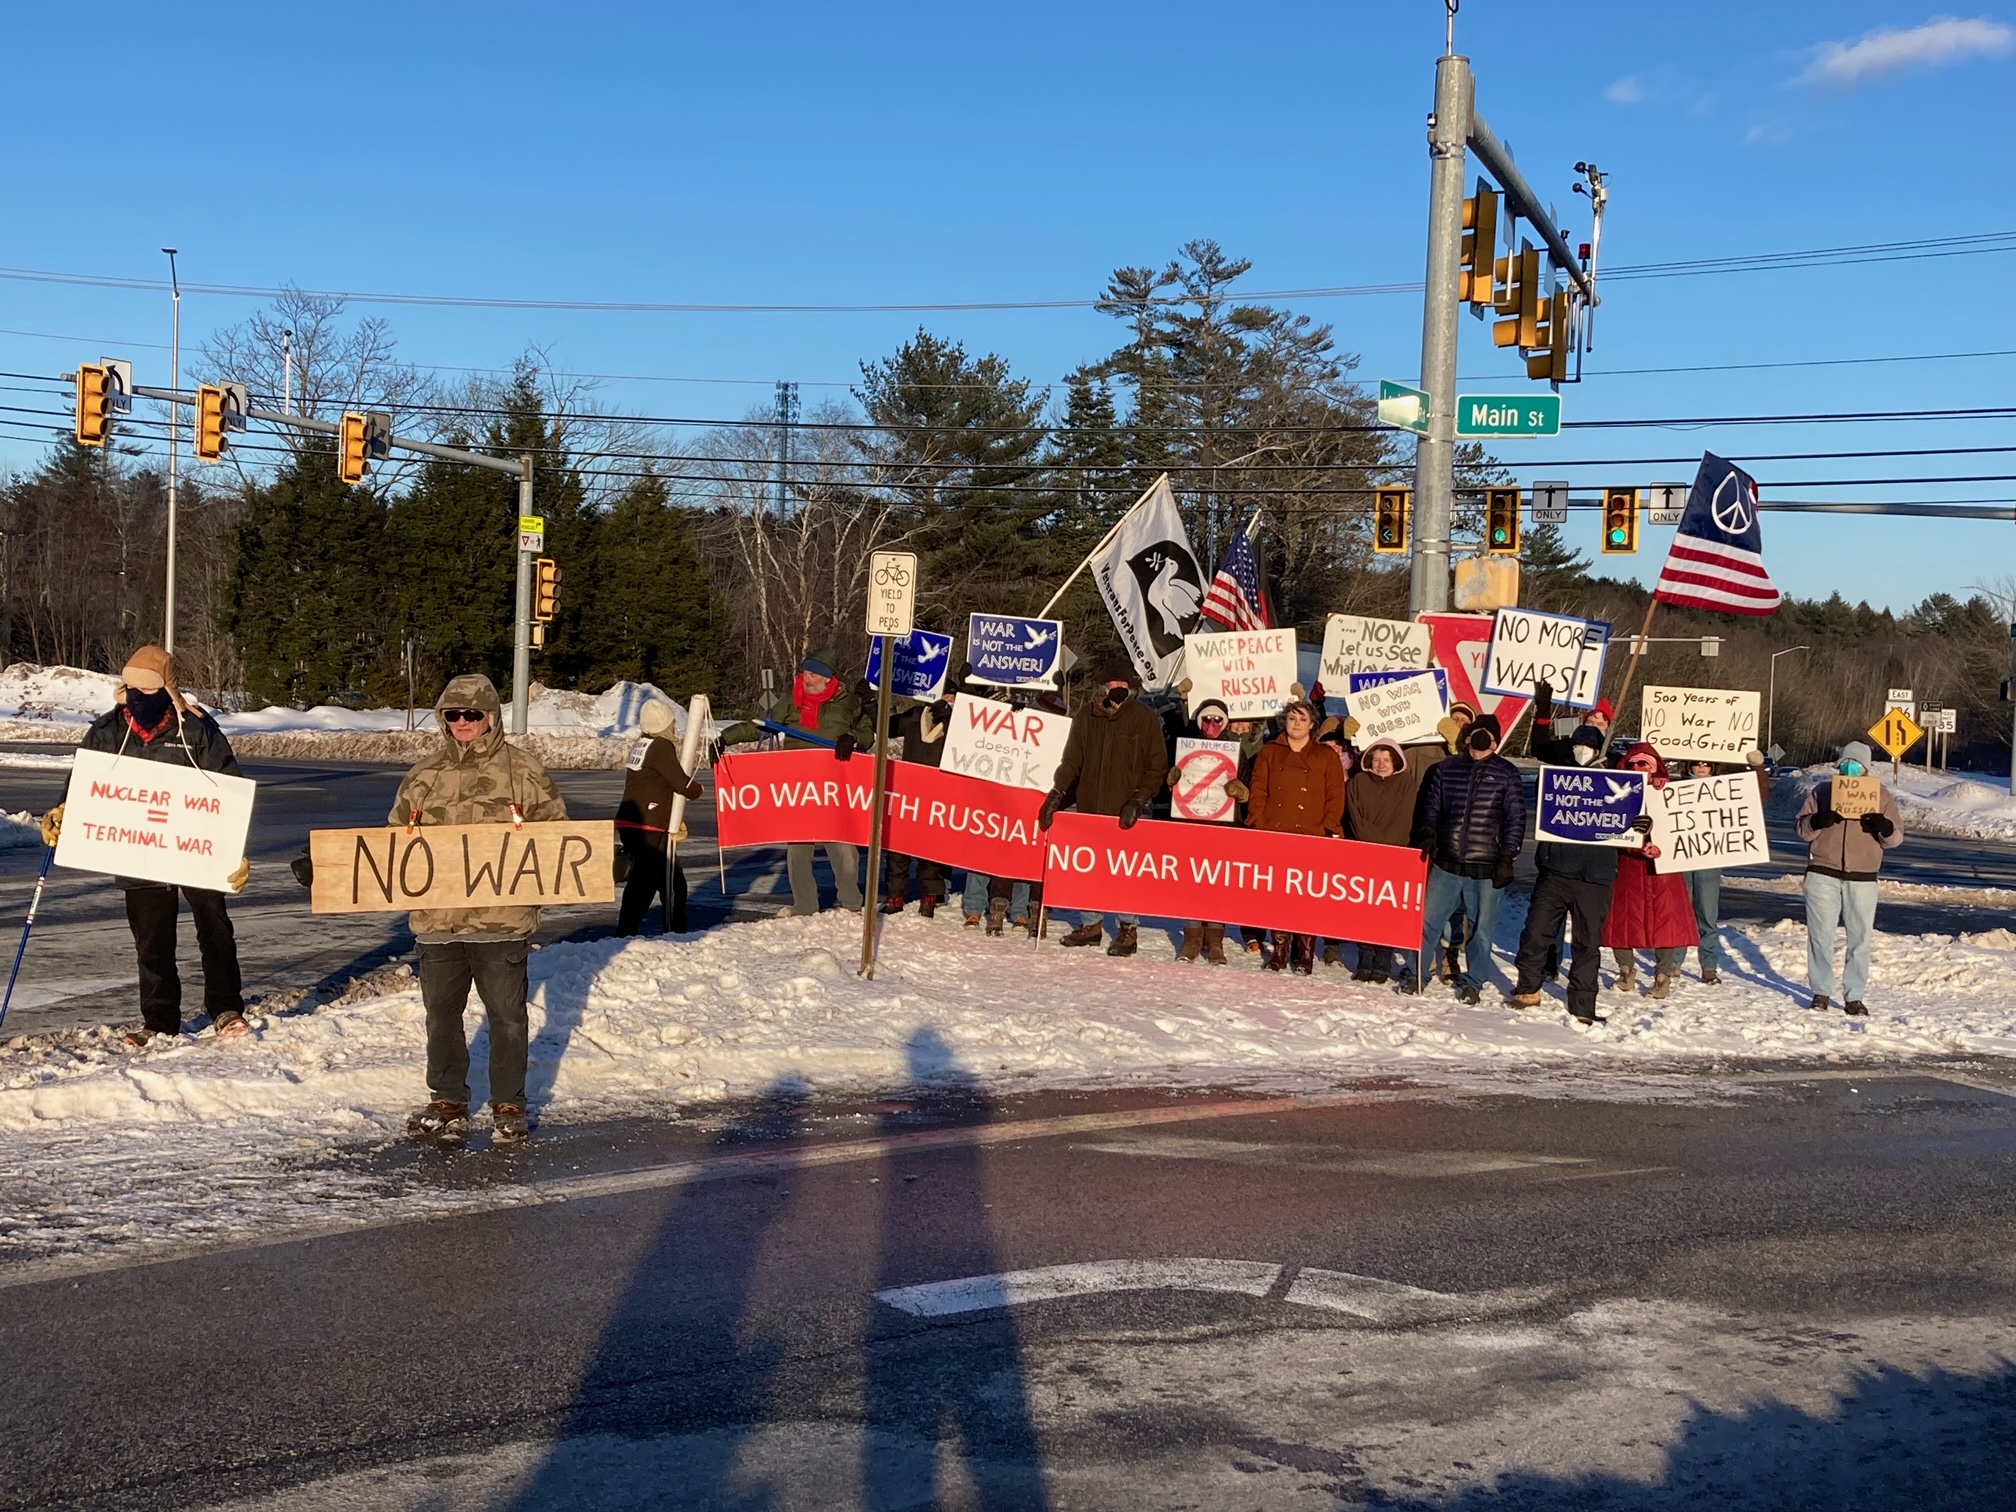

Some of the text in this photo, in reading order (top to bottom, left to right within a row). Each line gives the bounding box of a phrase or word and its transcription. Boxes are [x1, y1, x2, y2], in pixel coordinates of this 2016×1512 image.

[1471, 403, 1544, 427] Main St
[1536, 510, 1562, 519] ONLY
[1653, 512, 1680, 521] ONLY
[880, 588, 902, 600] YIELD
[886, 603, 895, 613] TO
[878, 616, 899, 628] PEDS
[980, 620, 1016, 638] WAR
[1362, 620, 1411, 644] NOW
[1499, 614, 1603, 651] NO MORE
[893, 636, 911, 649] AR
[972, 638, 1023, 652] IS NOT THE
[1194, 635, 1284, 658] WAGE PEACE
[1340, 639, 1361, 656] Let
[1365, 646, 1384, 657] us
[873, 647, 880, 655] IS
[901, 655, 916, 665] THE
[977, 653, 1043, 672] ANSWER!
[874, 667, 932, 689] SWER!
[1221, 675, 1277, 697] RUSSIA
[1496, 657, 1588, 698] WARS!
[1358, 681, 1422, 711] NO WAR
[1892, 690, 1909, 698] EAST
[1377, 700, 1411, 718] WITH
[1643, 707, 1754, 731] NO War NO
[968, 702, 1044, 747] WAR
[1366, 712, 1420, 737] RUSSIA
[975, 737, 1032, 760] doesn't
[1180, 739, 1237, 752] NO NUKES
[951, 746, 1040, 787] WORK
[1552, 774, 1594, 792] WAR
[1662, 778, 1744, 809] PEACE
[1839, 779, 1860, 789] NO
[90, 781, 221, 814] NUCLEAR WAR
[718, 784, 760, 812] NO
[770, 781, 839, 808] WAR
[846, 786, 919, 822] WTH
[1544, 793, 1604, 807] IS NOT THE
[1847, 790, 1877, 801] WAR
[1550, 809, 1627, 829] ANSWER!
[1668, 806, 1749, 833] IS THE
[1835, 805, 1876, 814] RUSSIA
[83, 822, 213, 856] TERMINAL WAR
[1673, 829, 1760, 860] ANSWER
[352, 832, 593, 904] NO WAR
[1048, 844, 1423, 911] NO WAR WITH RUSSIA!!
